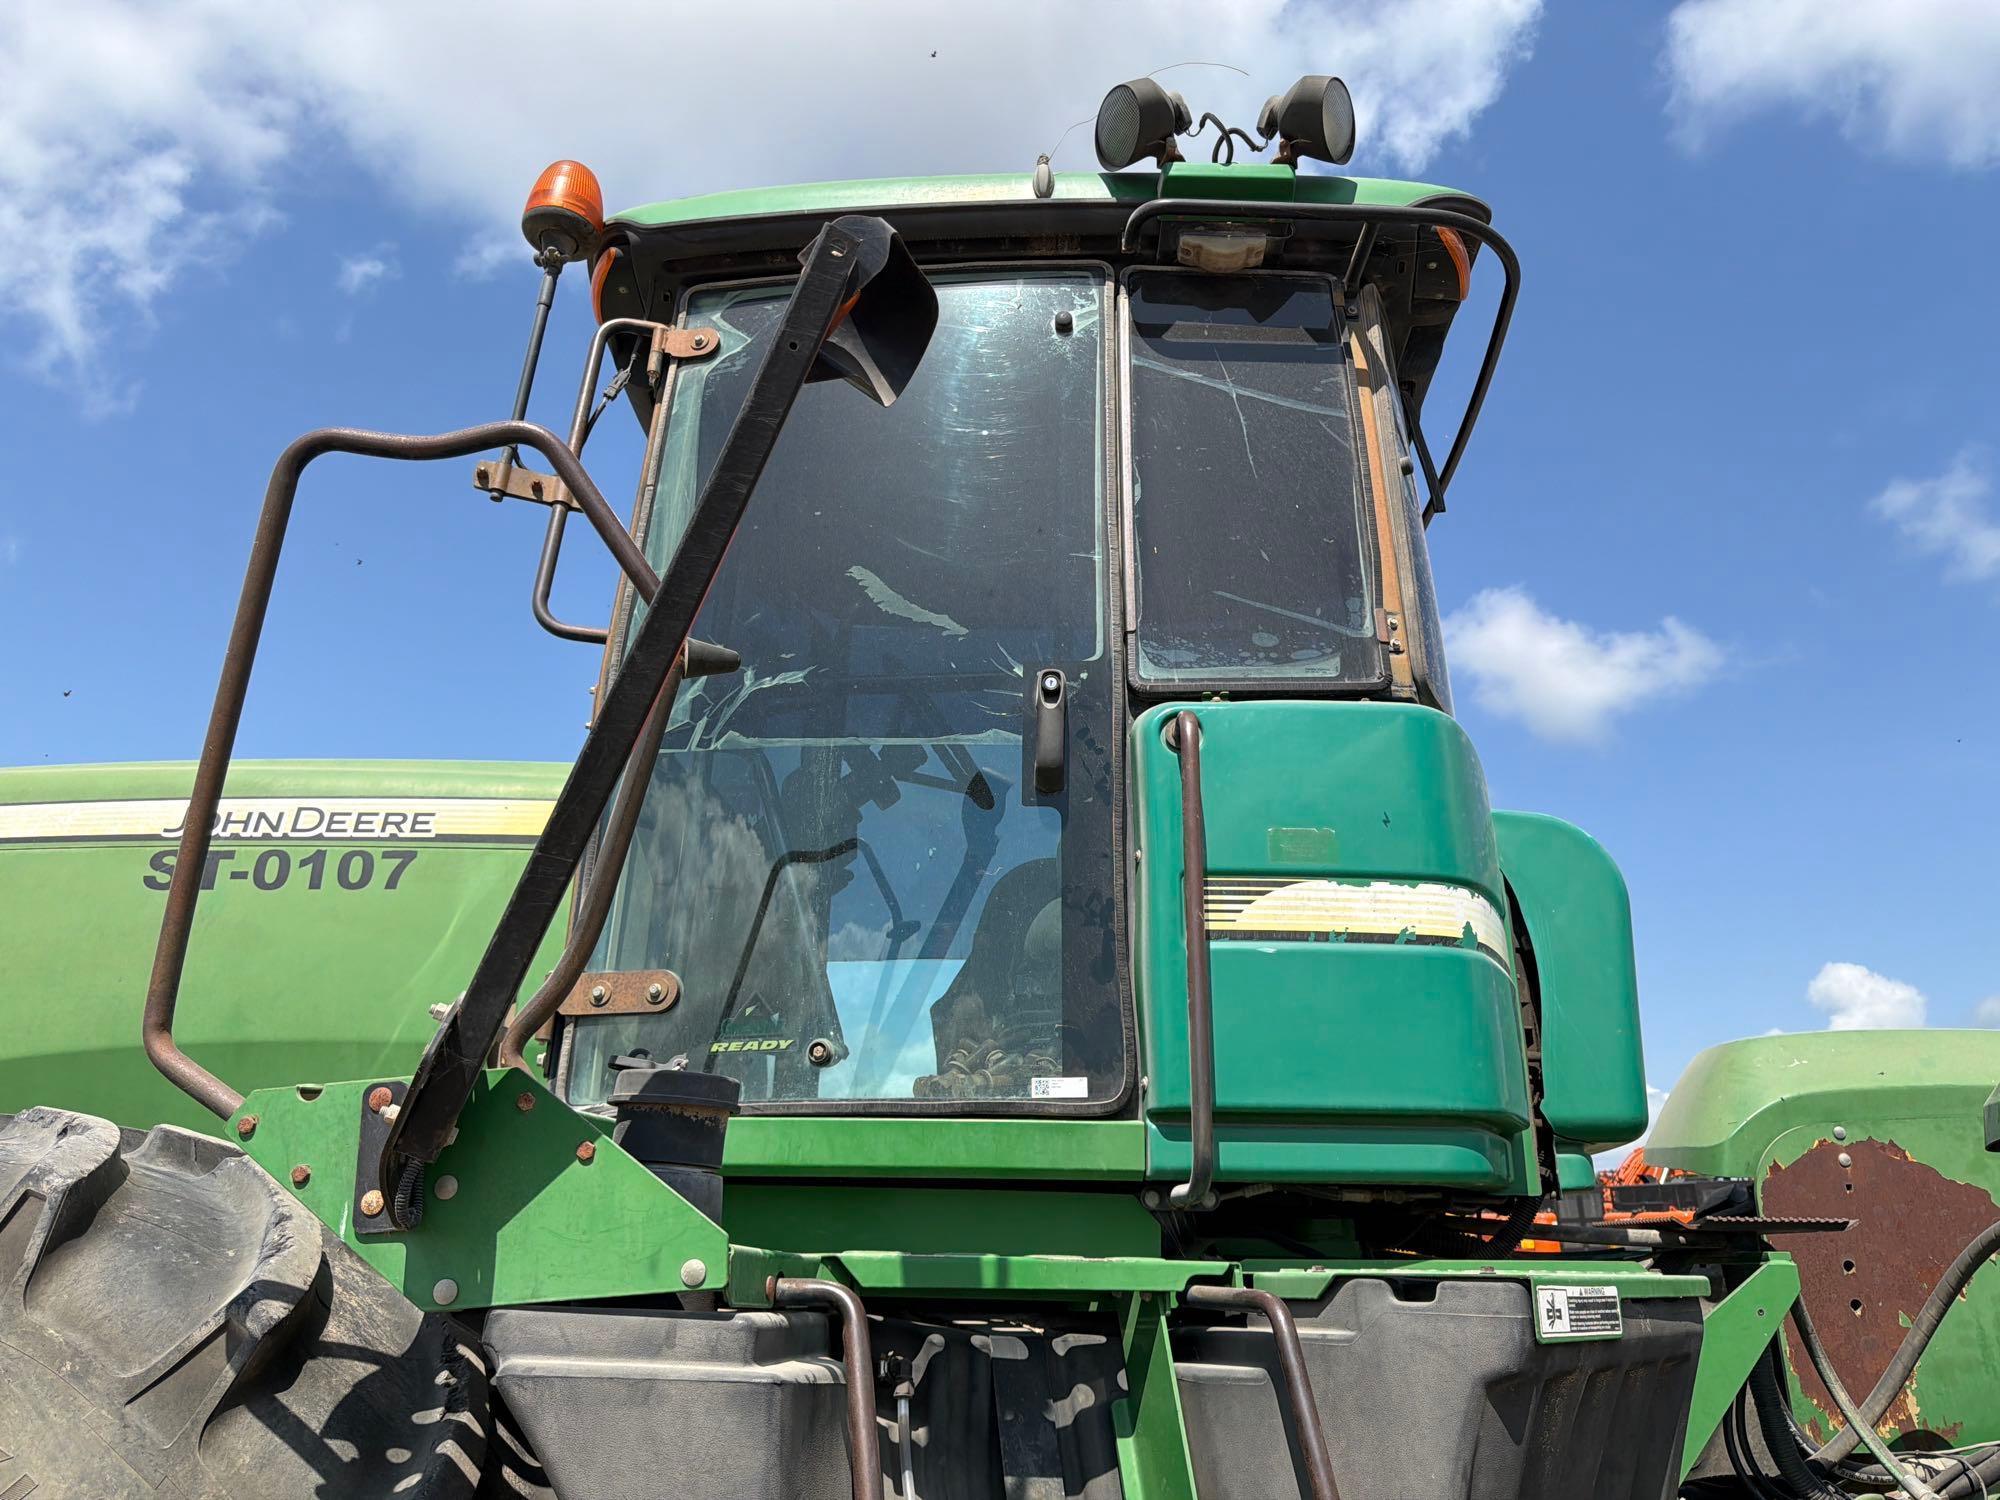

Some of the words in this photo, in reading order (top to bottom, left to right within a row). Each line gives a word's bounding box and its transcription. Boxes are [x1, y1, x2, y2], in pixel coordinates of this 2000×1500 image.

[290, 806, 437, 834] DEERE
[142, 848, 418, 891] ST-0107
[709, 1039, 795, 1053] READY
